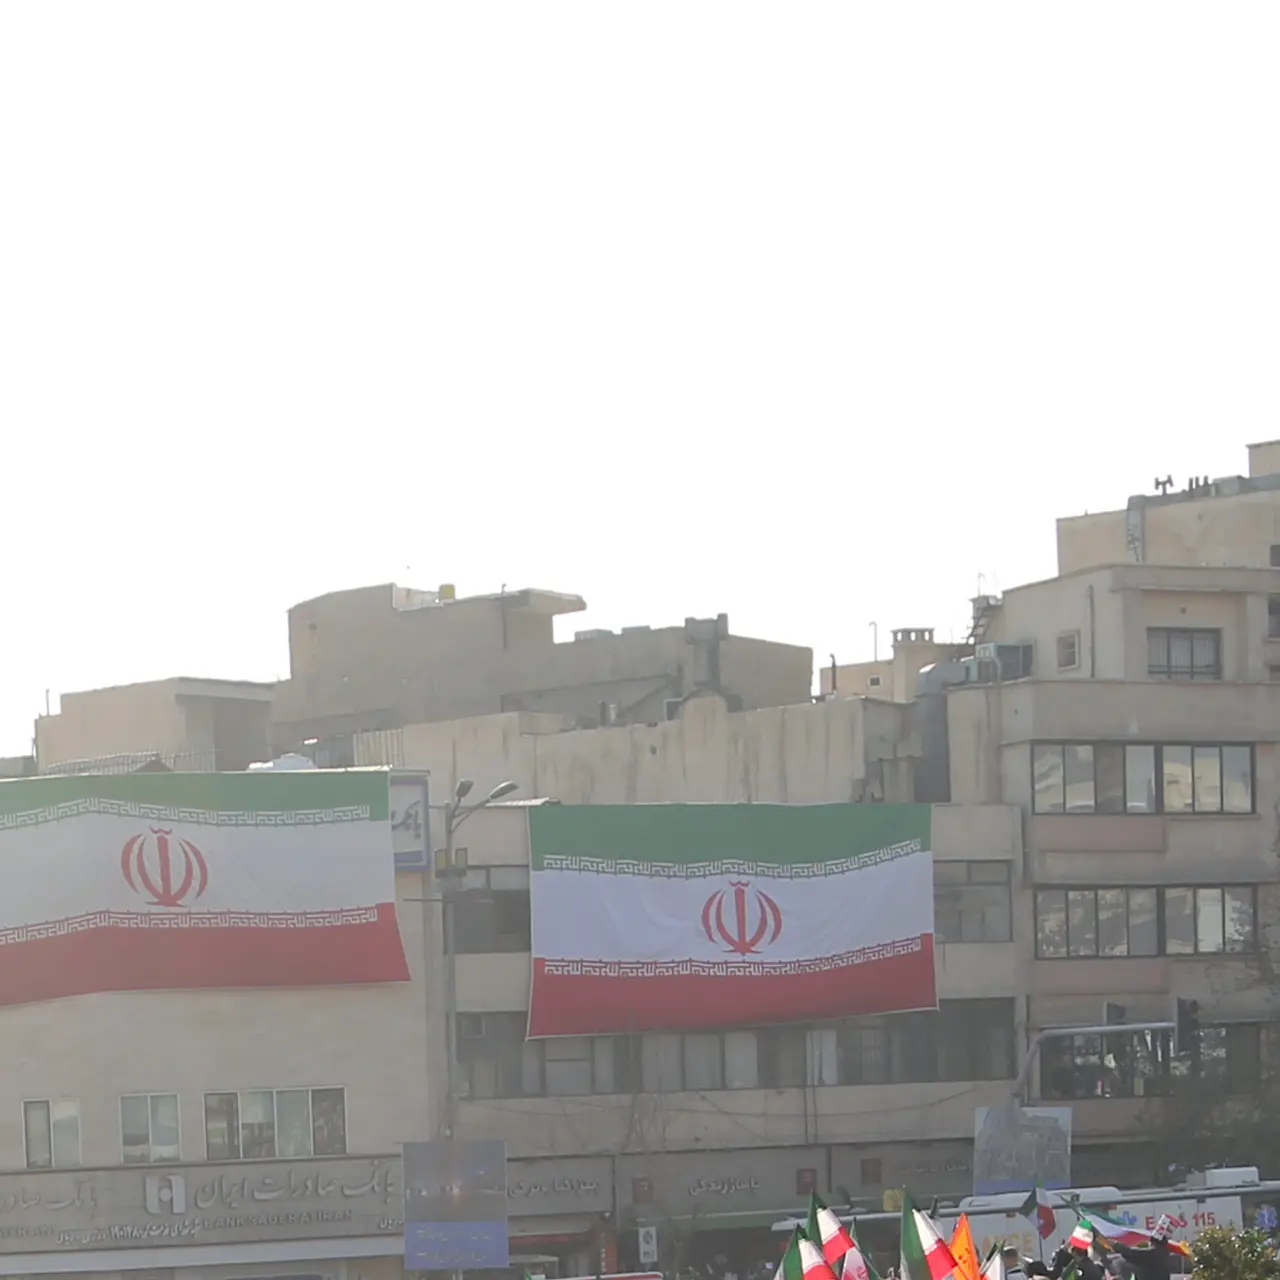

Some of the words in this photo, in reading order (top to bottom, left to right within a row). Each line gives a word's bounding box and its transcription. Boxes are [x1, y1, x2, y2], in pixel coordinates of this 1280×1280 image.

[194, 1174, 248, 1211] ایران
[252, 1168, 338, 1201] صادرات
[341, 1159, 395, 1205] بانک
[203, 1215, 244, 1229] BANK
[316, 1208, 355, 1222] IRAN
